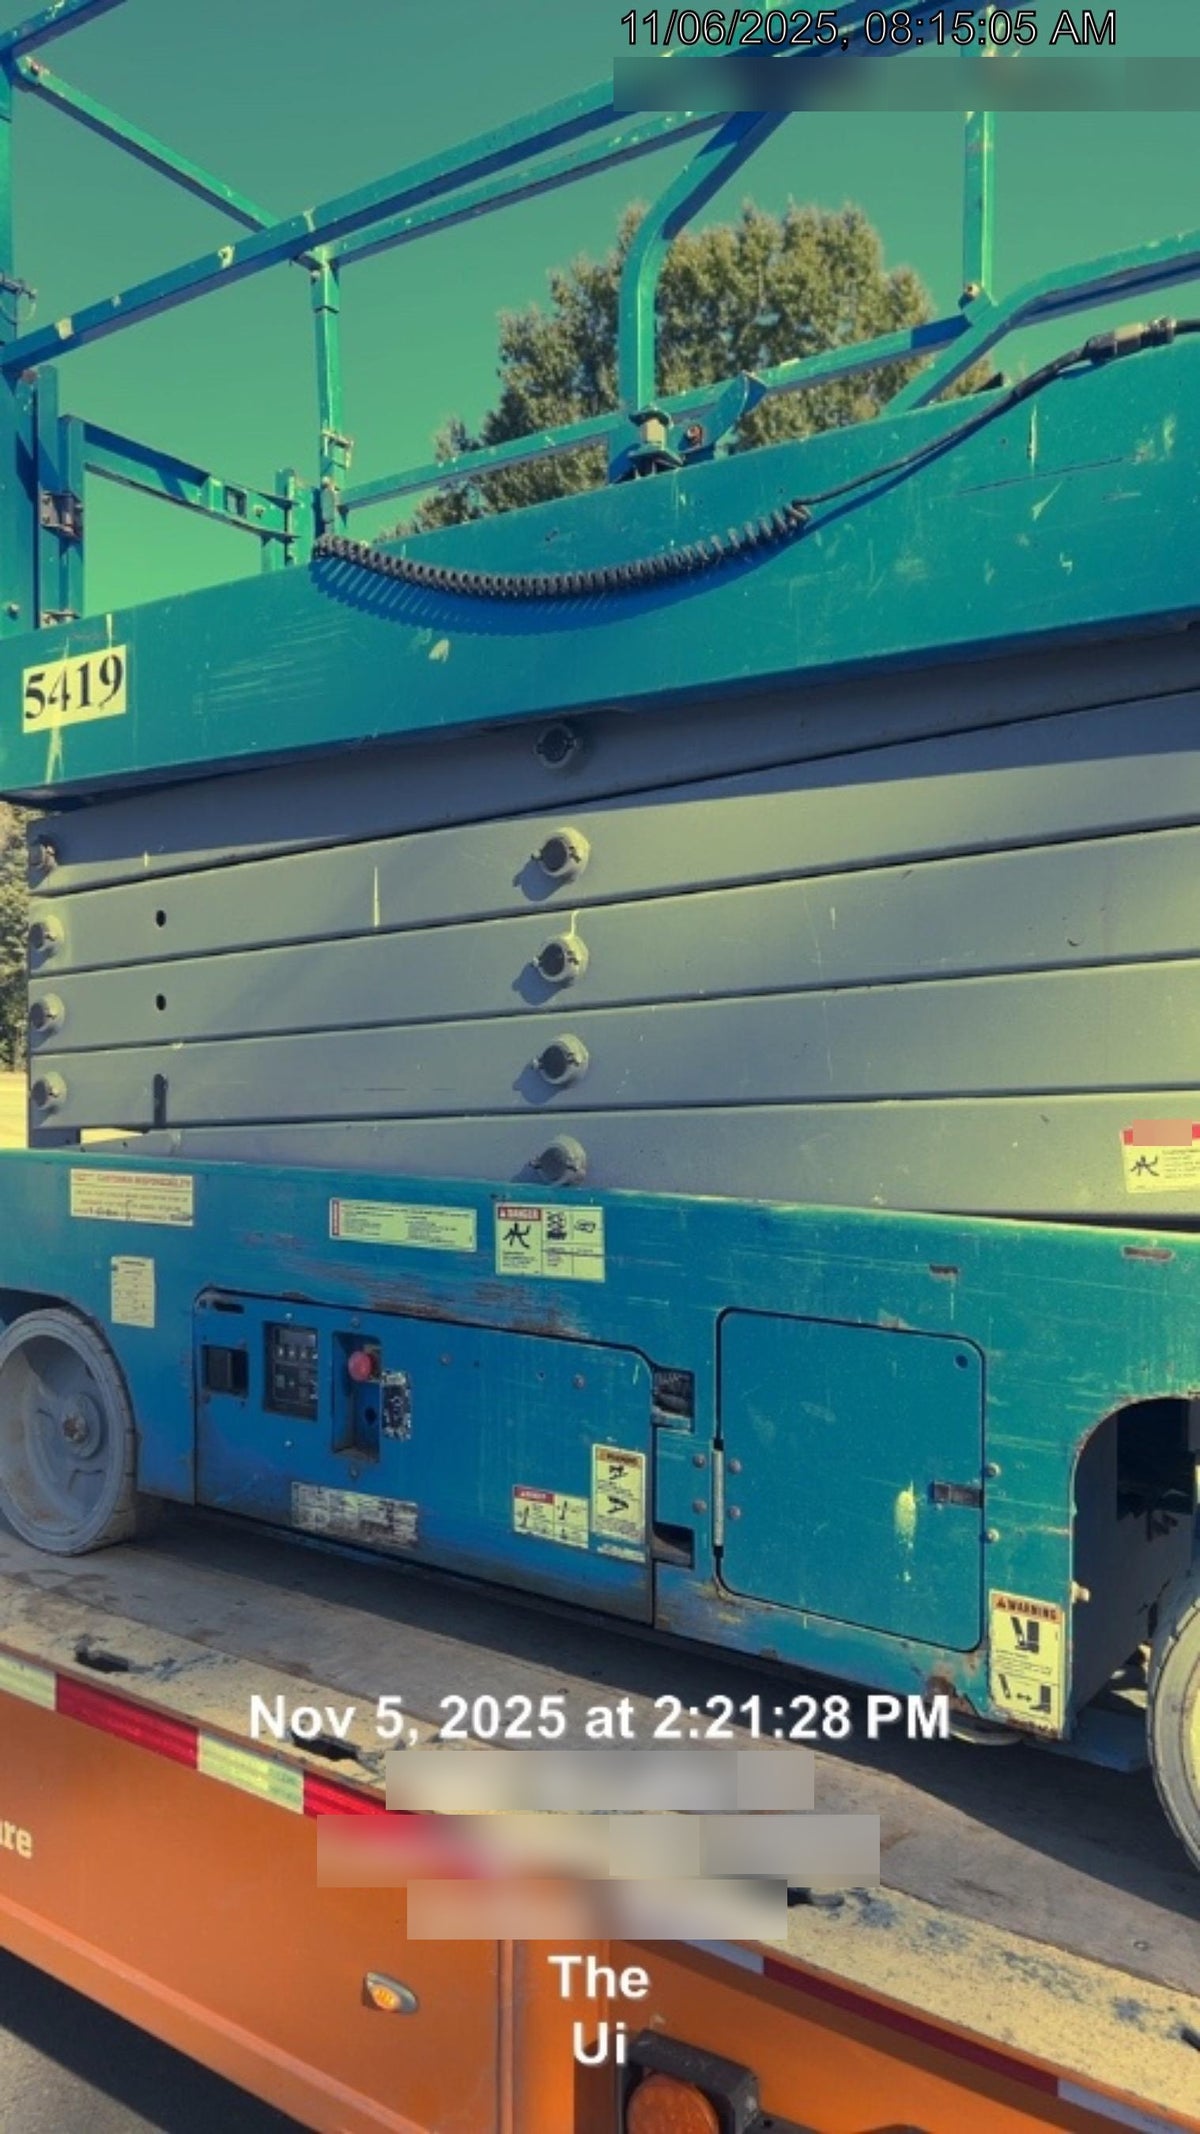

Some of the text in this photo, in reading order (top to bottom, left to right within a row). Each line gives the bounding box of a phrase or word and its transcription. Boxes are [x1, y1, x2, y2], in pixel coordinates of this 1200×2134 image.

[25, 654, 123, 719] 5419
[1007, 1600, 1057, 1620] WARNING
[0, 1819, 33, 1859] re
